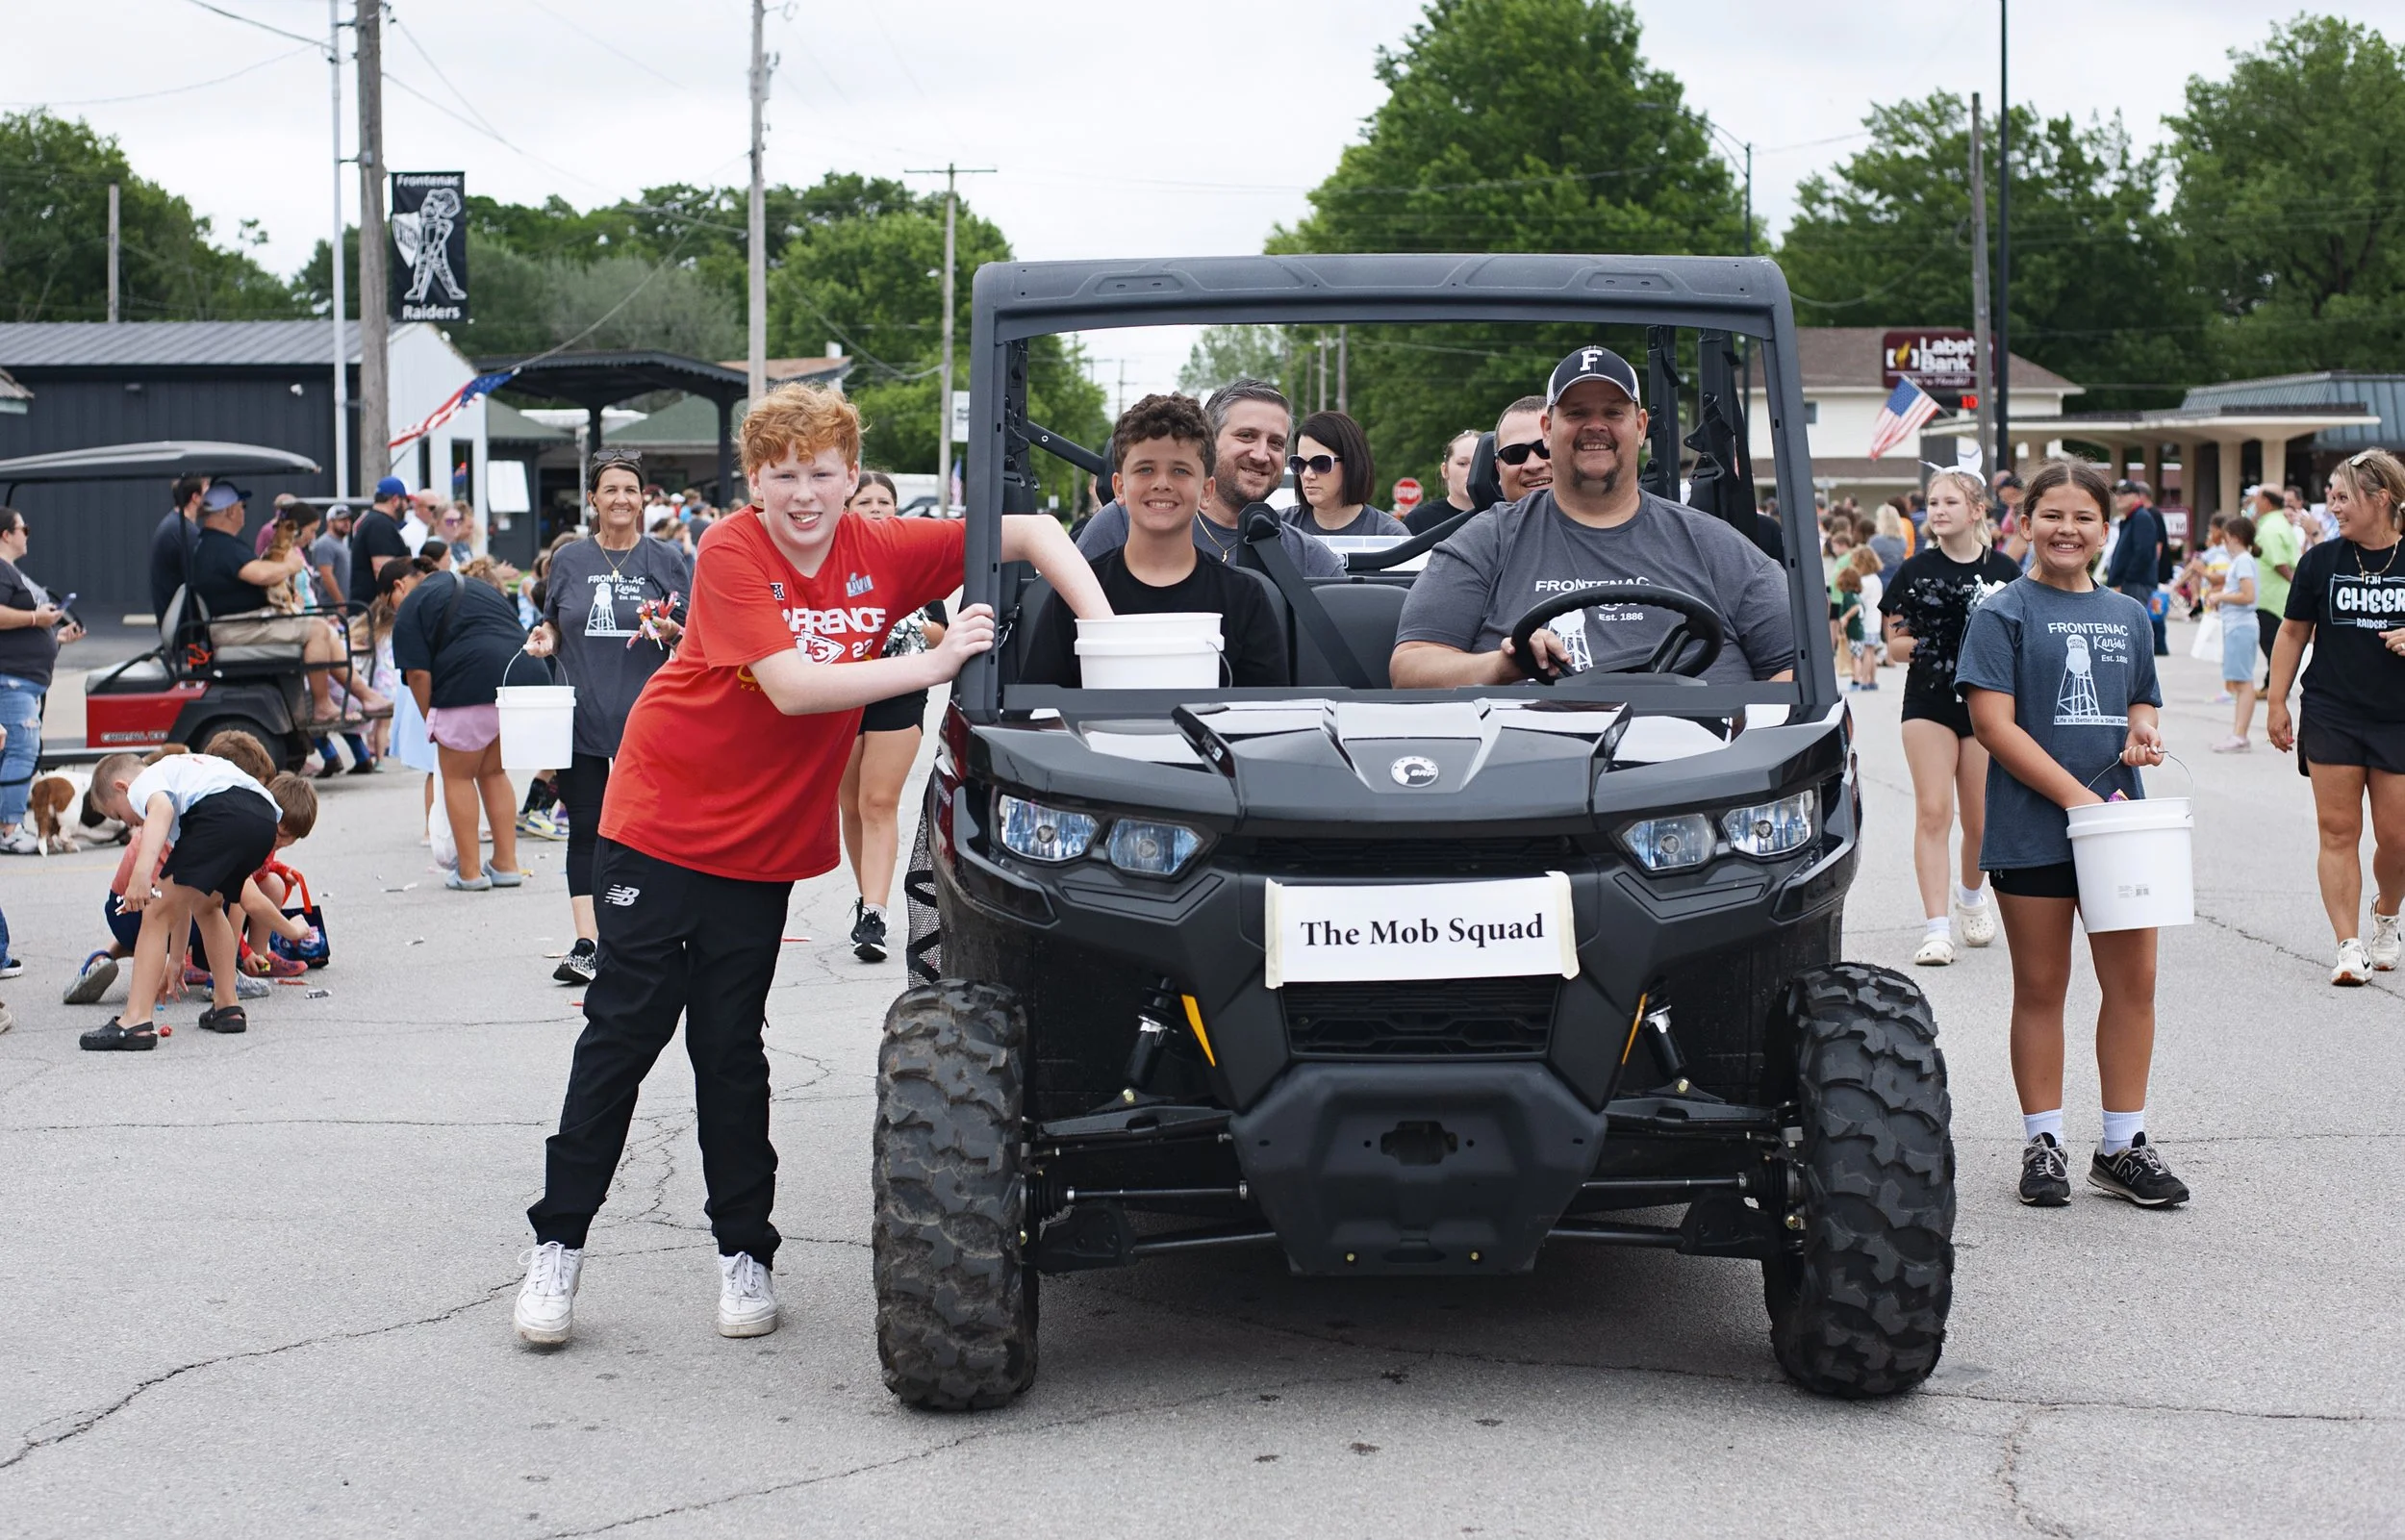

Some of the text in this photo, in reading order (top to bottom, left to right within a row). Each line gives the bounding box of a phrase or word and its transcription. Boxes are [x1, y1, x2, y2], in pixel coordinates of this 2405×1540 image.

[396, 174, 460, 187] Frontenac
[402, 304, 461, 320] Raiders
[1580, 349, 1603, 371] F
[1920, 352, 1971, 373] Bank
[588, 574, 646, 585] FRONTEAC
[2366, 575, 2381, 585] FJH
[1599, 613, 1617, 621] Est.
[2357, 618, 2388, 629] RAIDERS
[2047, 621, 2129, 636] FRONTENAC
[2093, 635, 2126, 652] Kansas
[1301, 913, 1545, 948] The Mob Squad
